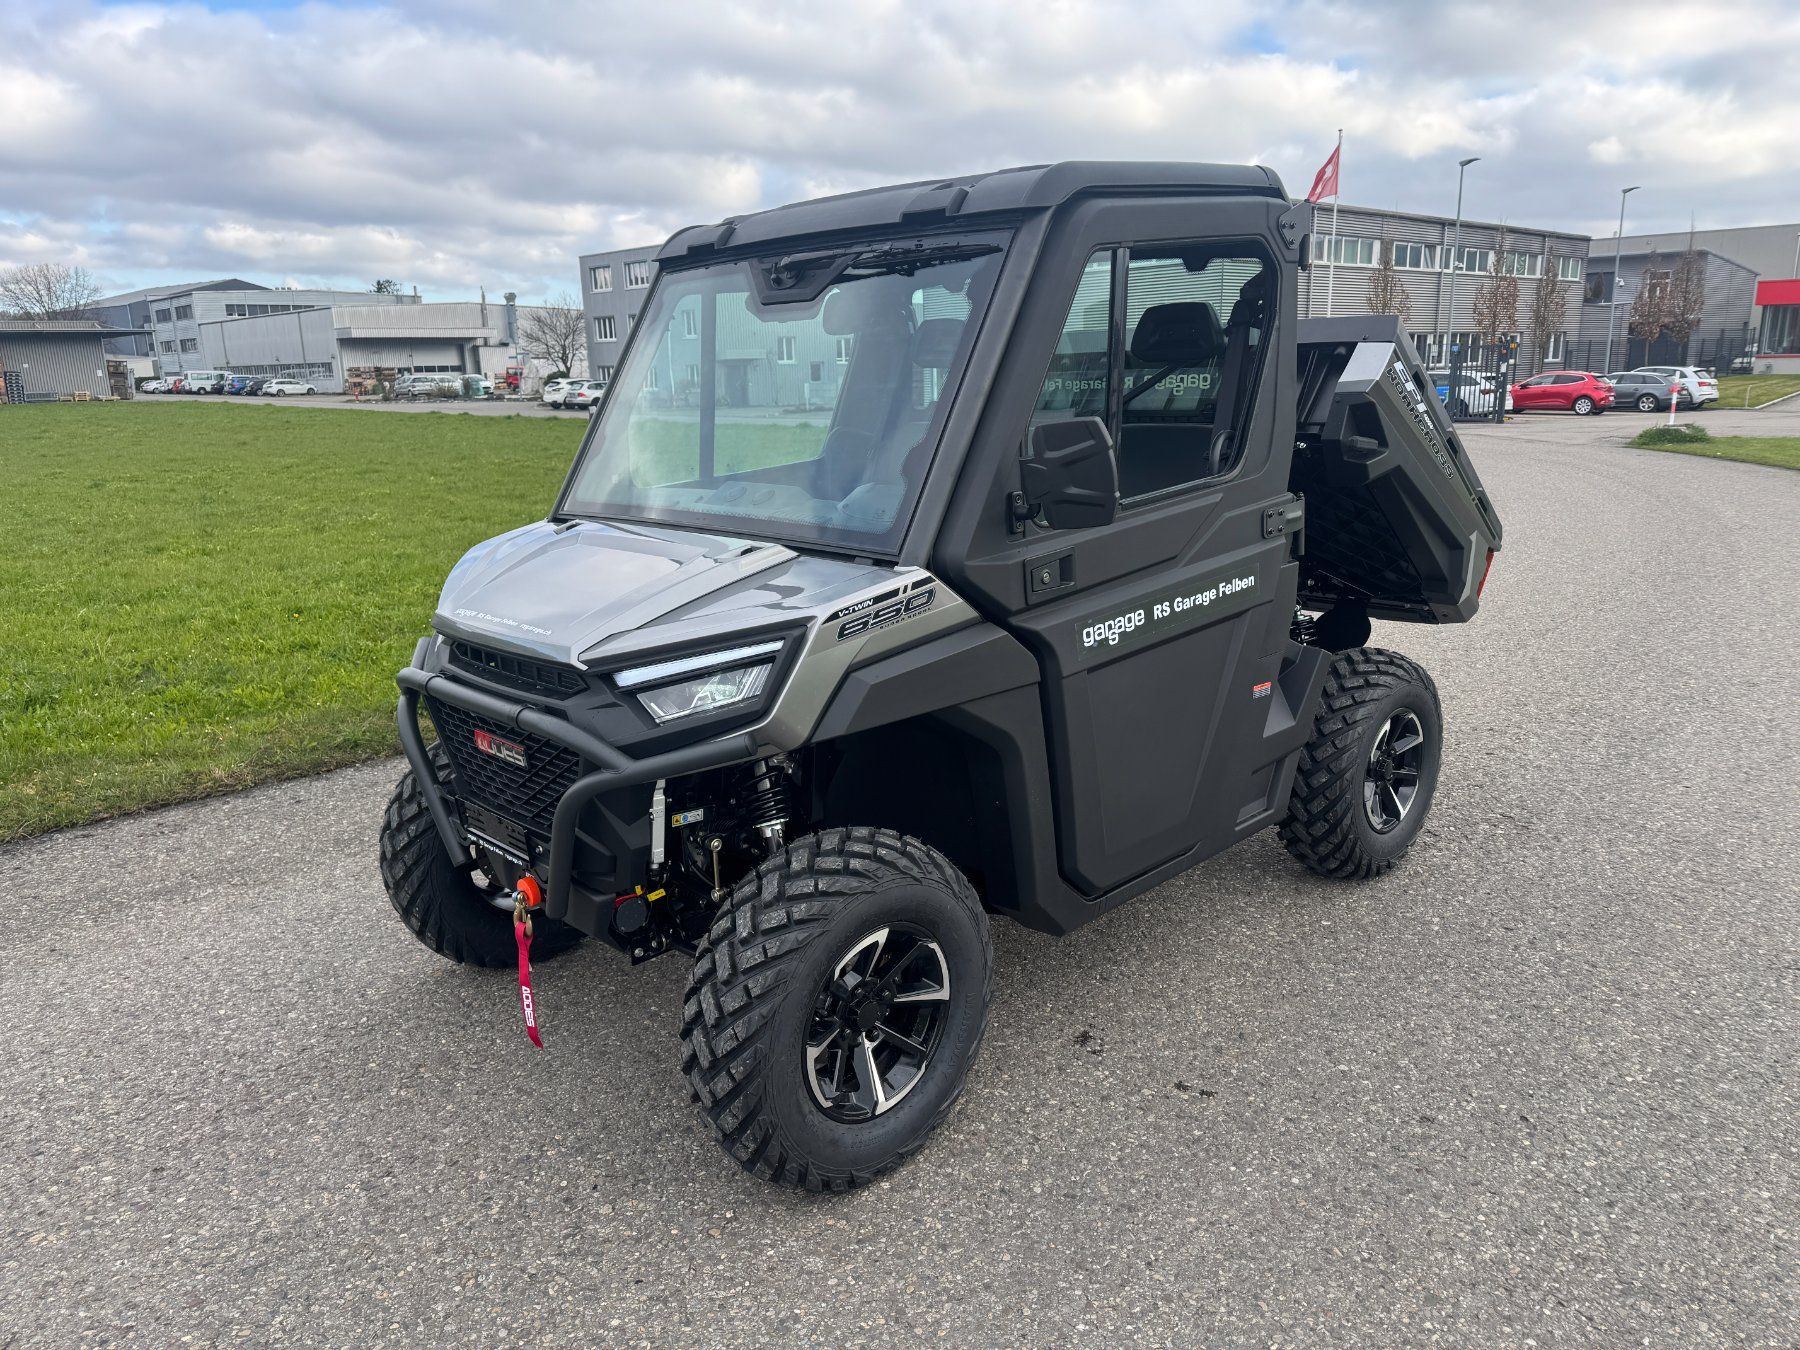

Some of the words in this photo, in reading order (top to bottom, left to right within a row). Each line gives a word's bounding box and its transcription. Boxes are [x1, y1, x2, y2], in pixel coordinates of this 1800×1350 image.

[1386, 367, 1454, 479] WORKCROSS
[836, 586, 937, 642] 650
[838, 598, 874, 618] V-TWIN
[1153, 601, 1170, 620] RS
[1174, 587, 1217, 612] Garage
[1219, 575, 1255, 597] Felben
[521, 985, 535, 1028] AODES
